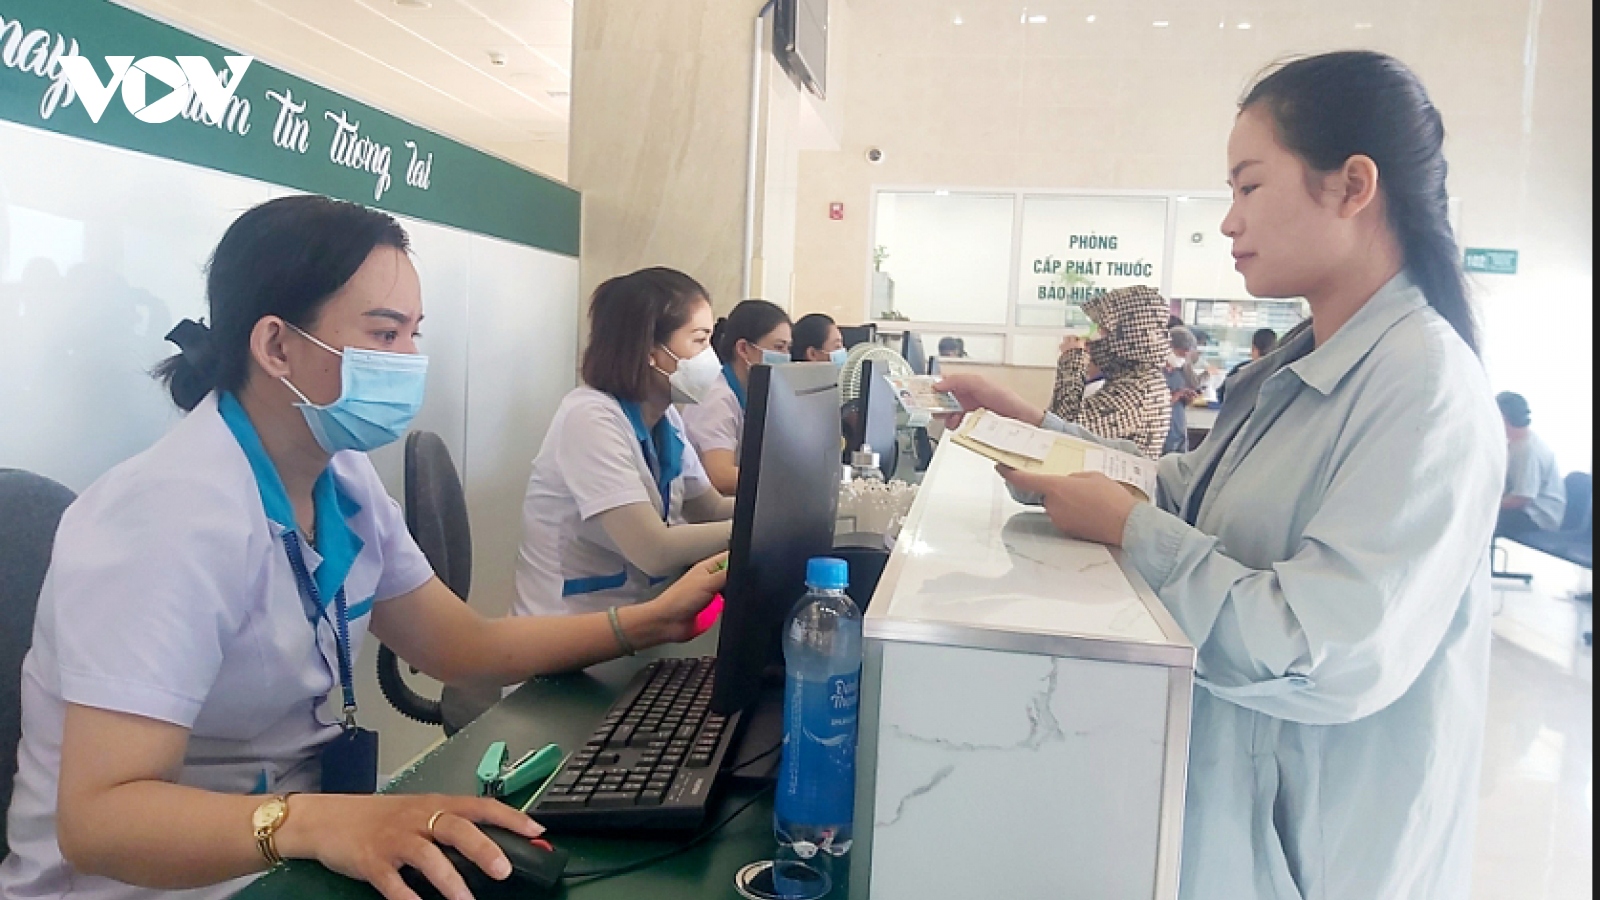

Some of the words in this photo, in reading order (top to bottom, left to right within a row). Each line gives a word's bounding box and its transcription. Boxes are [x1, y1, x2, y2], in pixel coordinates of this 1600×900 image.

[1069, 230, 1118, 249] PHÒNG
[1033, 254, 1061, 274] CẤP
[1066, 258, 1102, 275] PHÁT
[1106, 257, 1153, 277] THUỐC
[1037, 281, 1066, 300] BẢO
